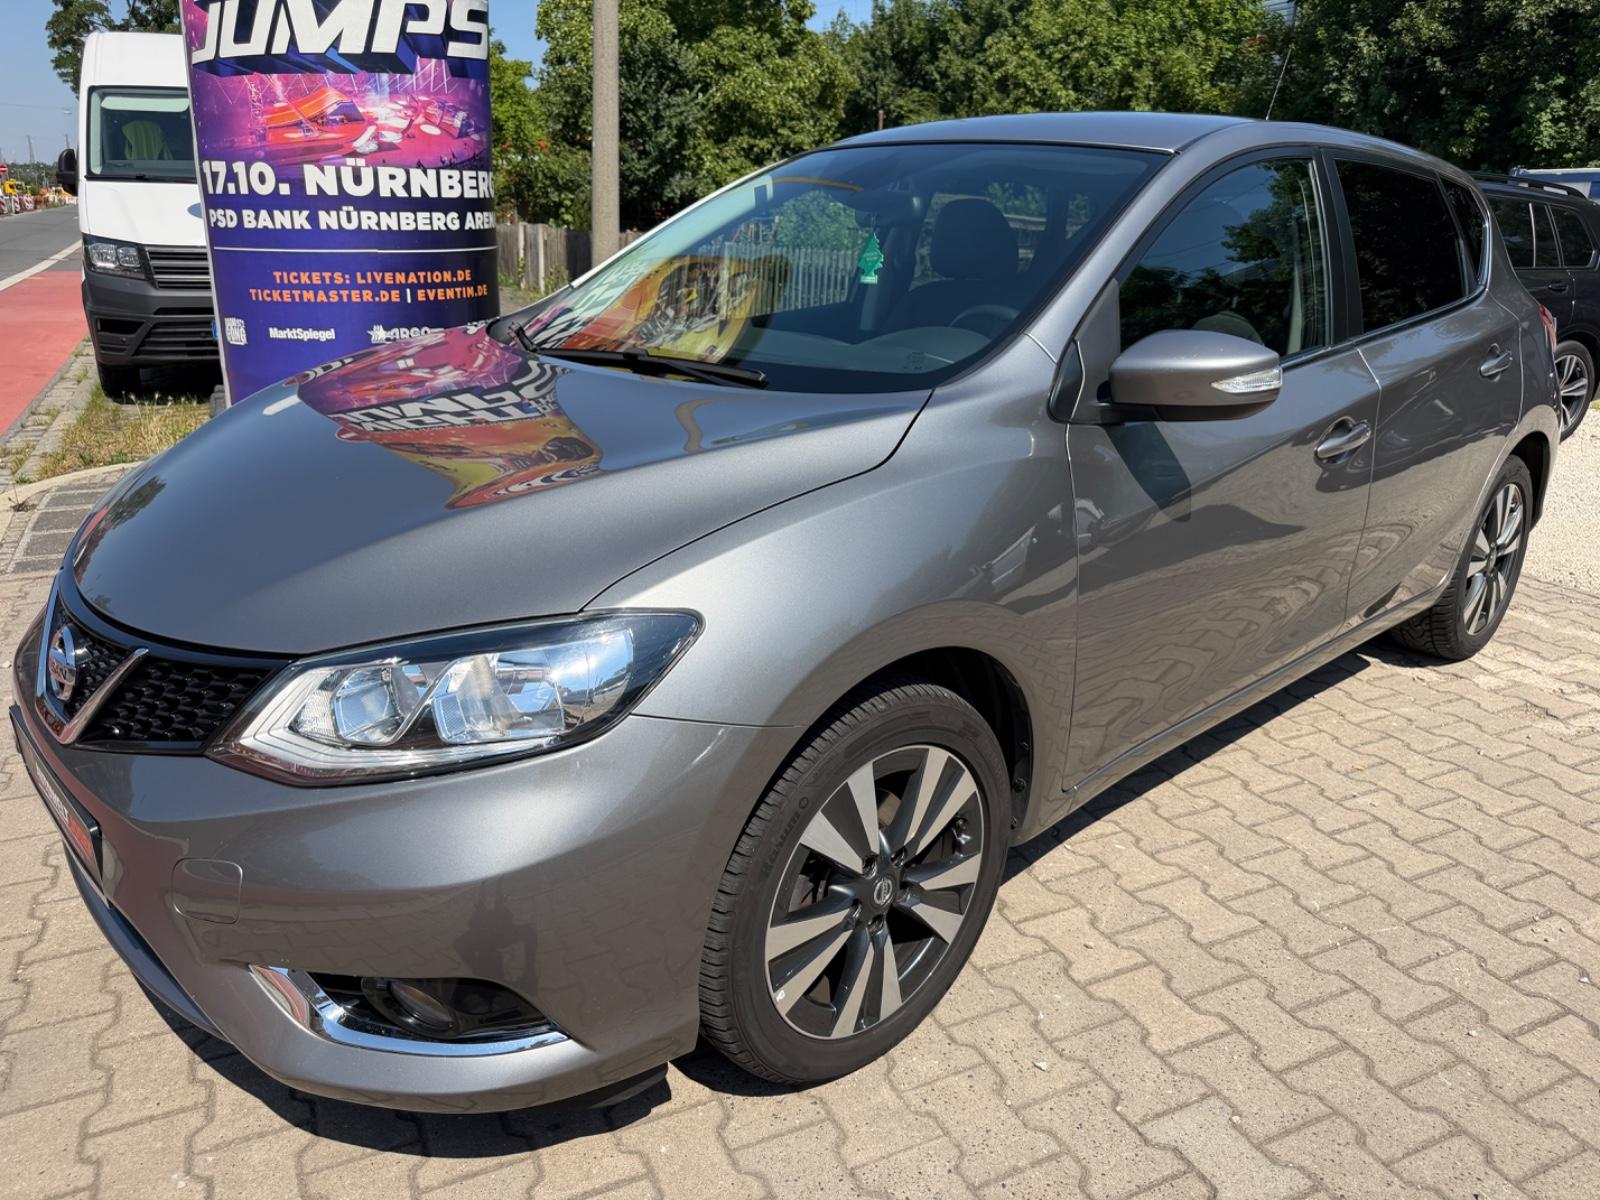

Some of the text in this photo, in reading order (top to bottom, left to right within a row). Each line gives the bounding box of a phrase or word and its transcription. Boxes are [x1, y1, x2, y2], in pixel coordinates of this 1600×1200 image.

[191, 0, 488, 63] JUMPS
[202, 160, 290, 196] 17.10.
[208, 208, 238, 228] PSD
[241, 208, 313, 230] BANK
[318, 205, 460, 231] NÜRNBERG
[273, 270, 471, 285] TICKETS: LIVENATION.DE
[249, 284, 488, 303] TICKETMASTER.DE EVENTIN.DE
[268, 327, 336, 342] MarktSpiegel
